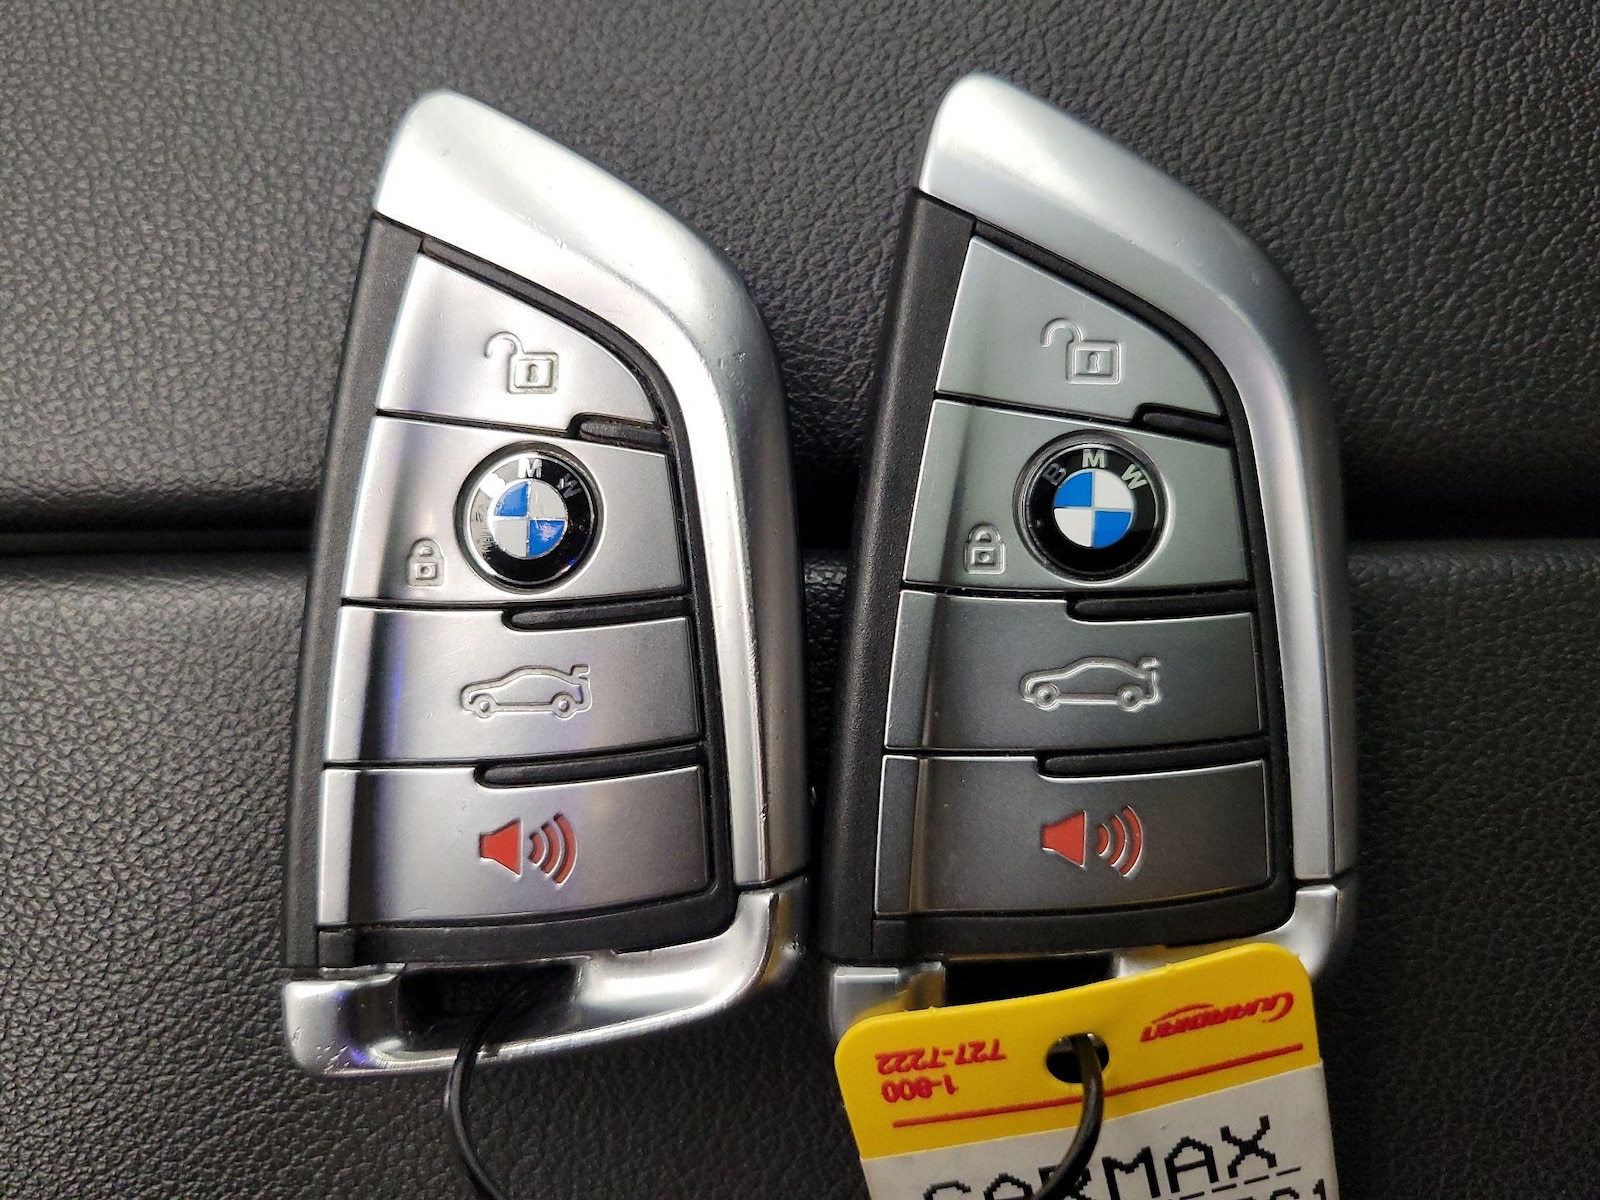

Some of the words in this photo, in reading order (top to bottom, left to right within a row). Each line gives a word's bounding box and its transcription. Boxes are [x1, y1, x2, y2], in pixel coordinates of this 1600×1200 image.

[1042, 449, 1149, 490] BMW
[874, 1039, 1007, 1075] 727-7222
[881, 1074, 959, 1103] 1-800
